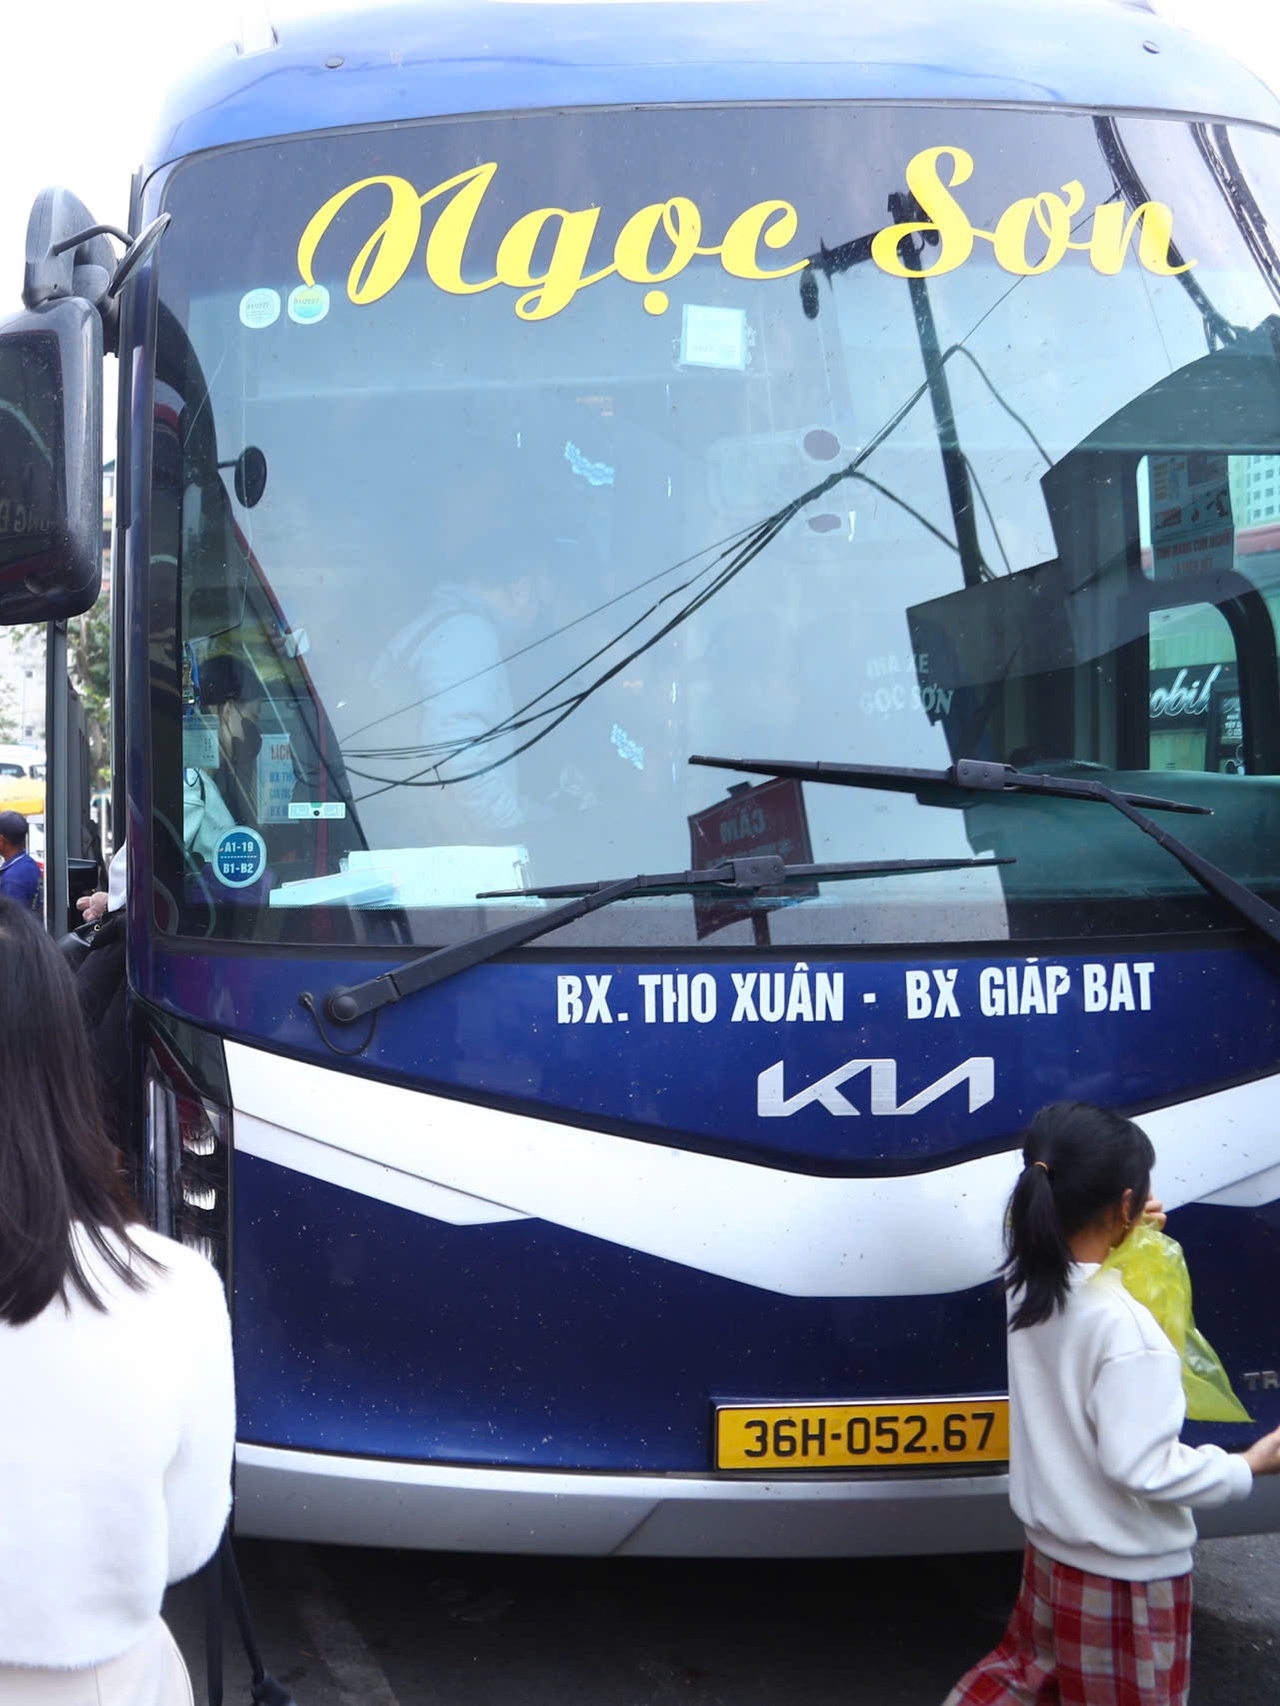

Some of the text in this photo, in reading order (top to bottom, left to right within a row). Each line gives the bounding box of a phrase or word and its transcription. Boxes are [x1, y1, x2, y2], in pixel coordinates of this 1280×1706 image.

[296, 146, 1199, 321] Ngọc Sơn
[224, 841, 254, 853] A1-19
[223, 862, 254, 874] B1-B2
[557, 973, 629, 1024] BX.
[638, 972, 717, 1023] THO
[730, 961, 845, 1022] XUÂN
[905, 968, 961, 1019] BX
[1083, 962, 1155, 1012] BAT
[1244, 1371, 1280, 1390] TR
[744, 1412, 995, 1458] 36H-052.67
